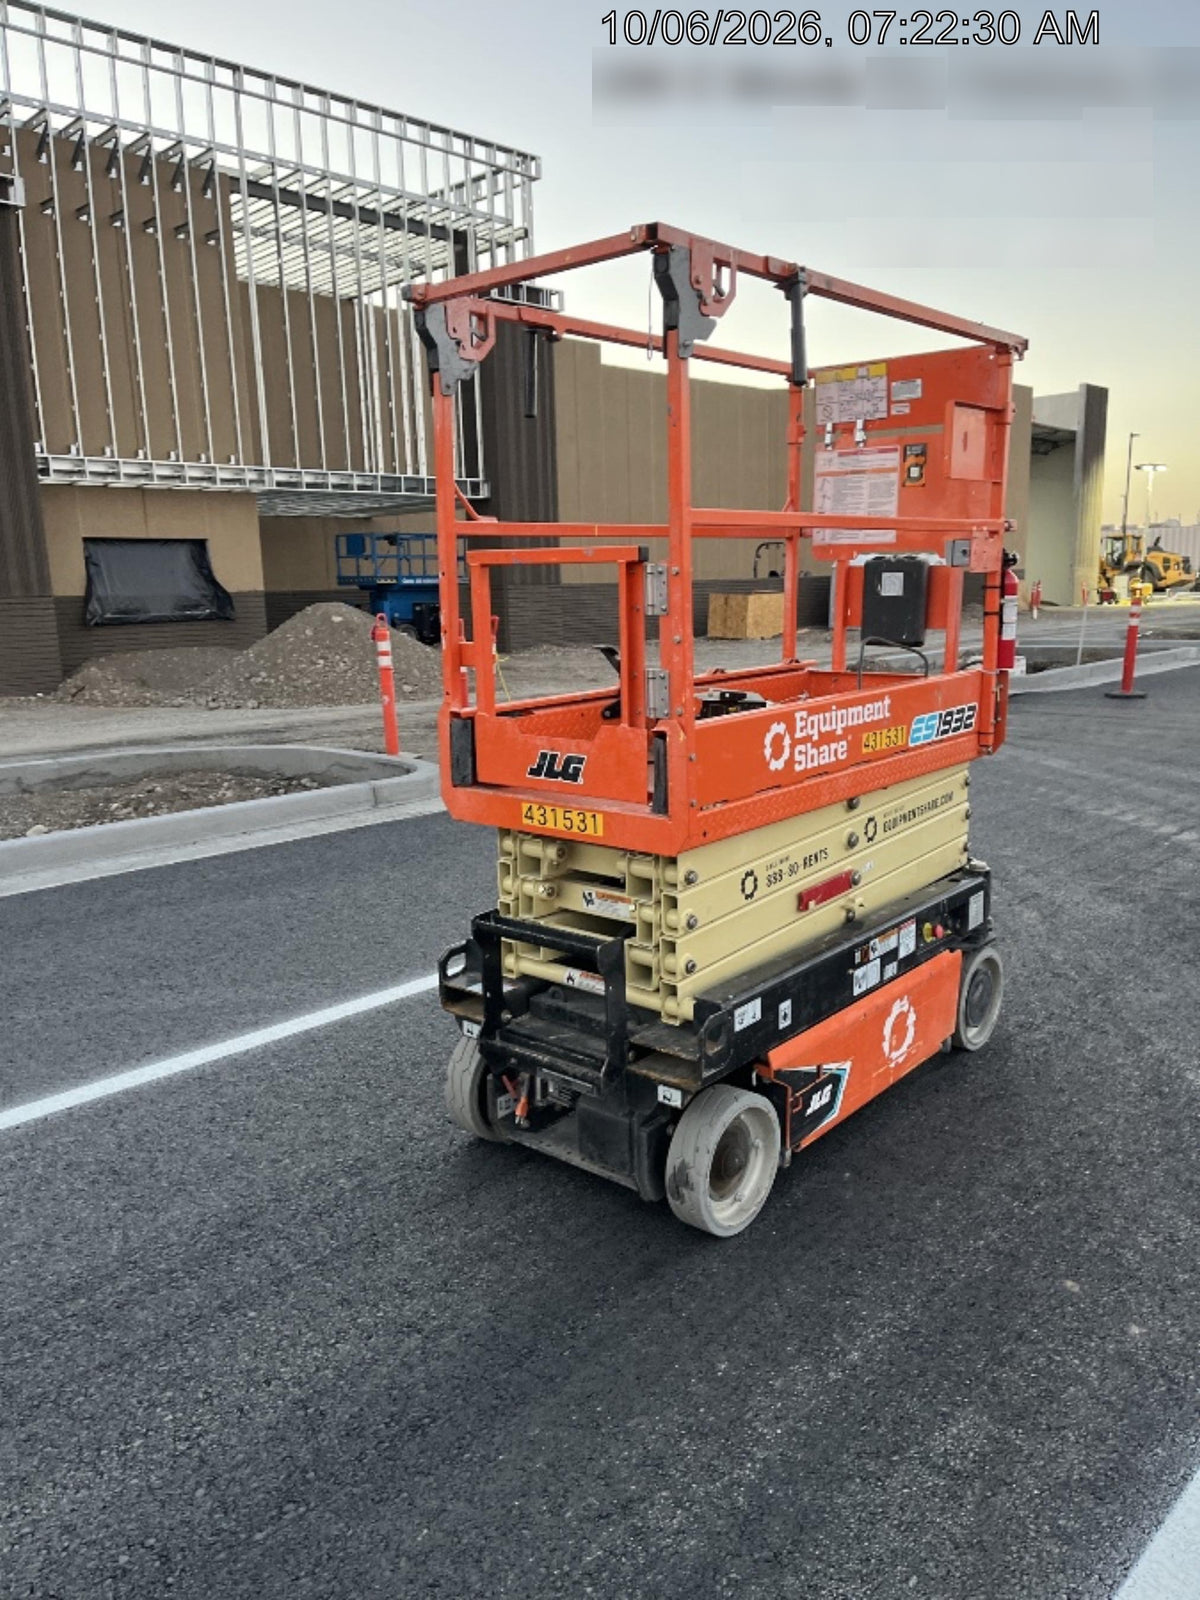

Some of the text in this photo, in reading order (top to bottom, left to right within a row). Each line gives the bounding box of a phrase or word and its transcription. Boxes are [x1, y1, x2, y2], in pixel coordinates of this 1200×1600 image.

[794, 695, 891, 741] Equipment
[910, 703, 977, 745] ES1932
[863, 726, 906, 752] 431531
[527, 750, 585, 783] JLG
[794, 740, 848, 772] Share
[523, 804, 600, 835] 431531
[804, 1083, 833, 1117] JLG
